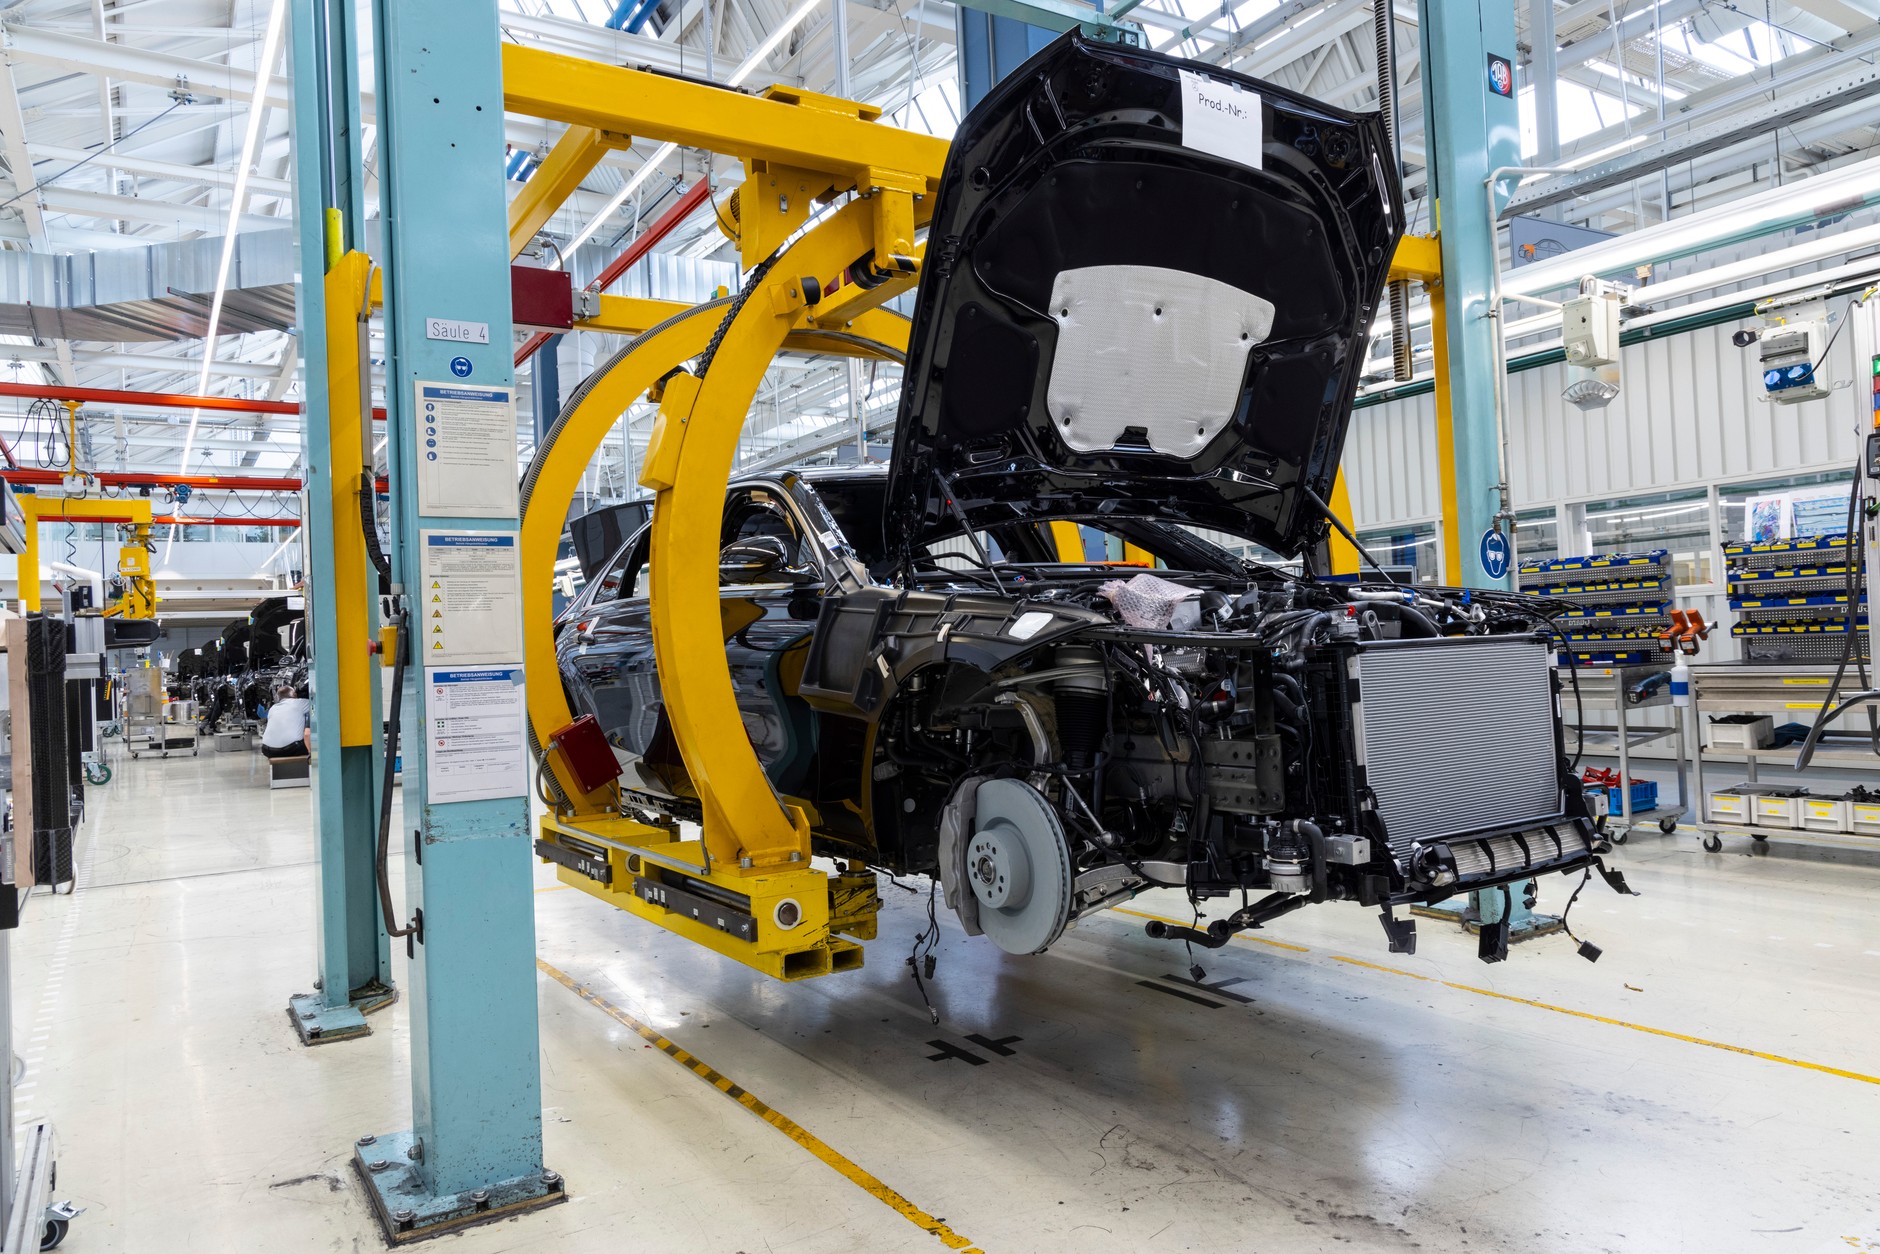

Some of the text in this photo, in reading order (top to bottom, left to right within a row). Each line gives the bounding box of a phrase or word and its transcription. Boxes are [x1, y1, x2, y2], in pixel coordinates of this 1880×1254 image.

[1199, 93, 1247, 119] Prod.-Nr.:
[432, 322, 486, 340] Säule 4
